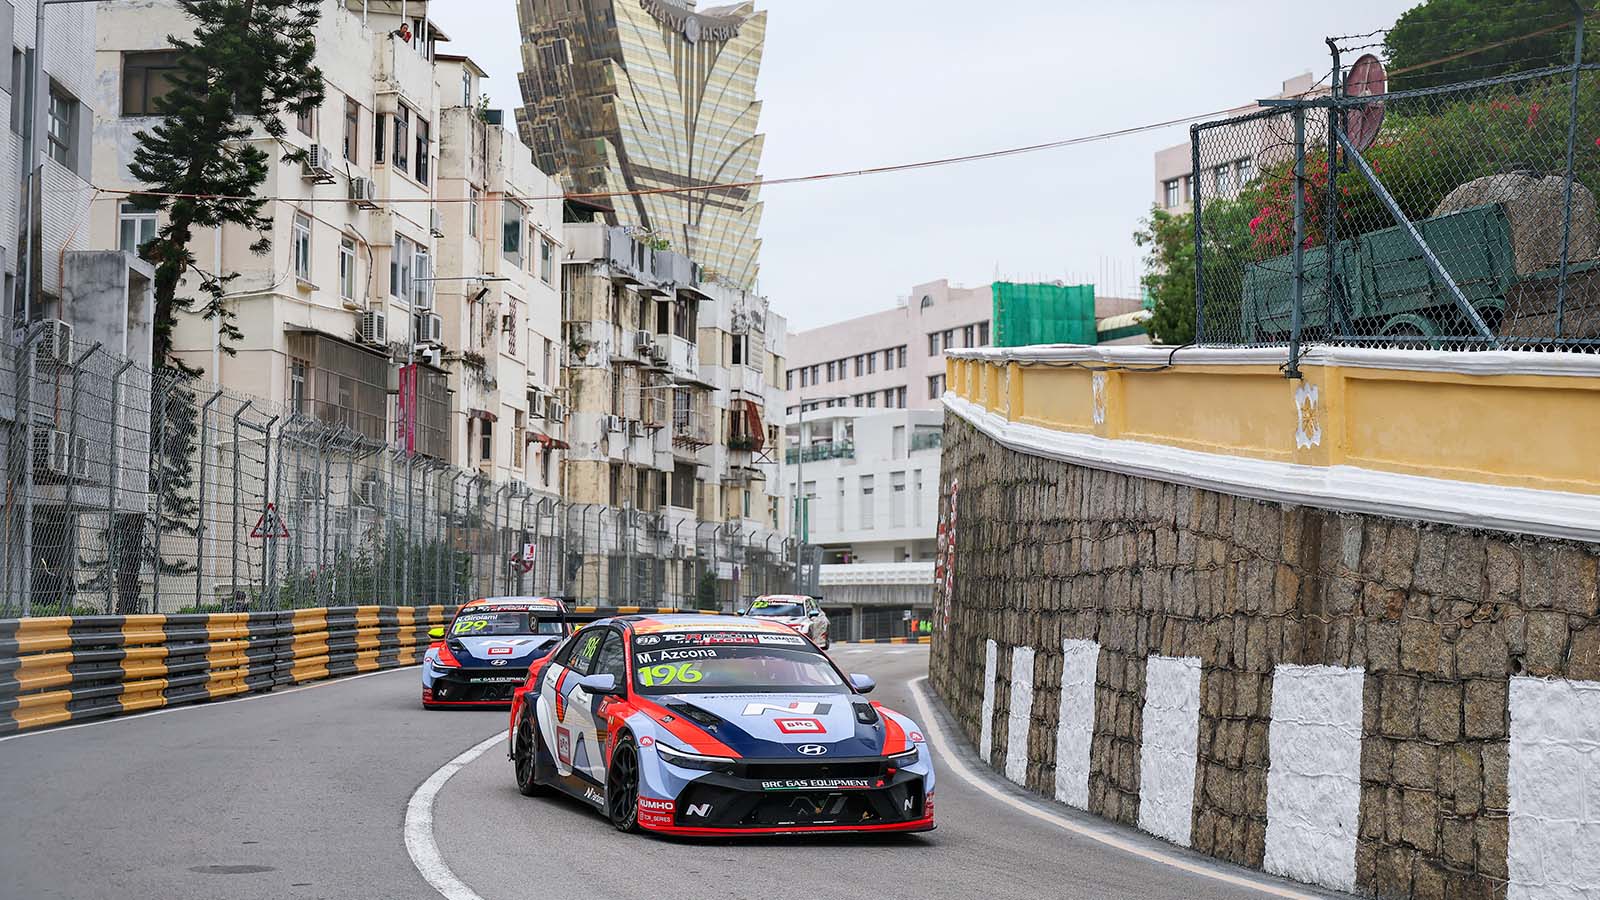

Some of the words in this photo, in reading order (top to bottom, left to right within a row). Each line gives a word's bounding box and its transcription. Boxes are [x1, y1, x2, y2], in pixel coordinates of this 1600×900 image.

[455, 620, 488, 633] 129
[663, 634, 702, 642] TCR
[636, 652, 657, 664] M.
[660, 649, 718, 661] Azcona
[637, 663, 703, 687] 196
[786, 720, 813, 728] BRC
[761, 780, 783, 788] BRC
[785, 780, 808, 788] GAS
[811, 779, 869, 787] EQUIPMENT
[640, 799, 674, 810] KUMHO
